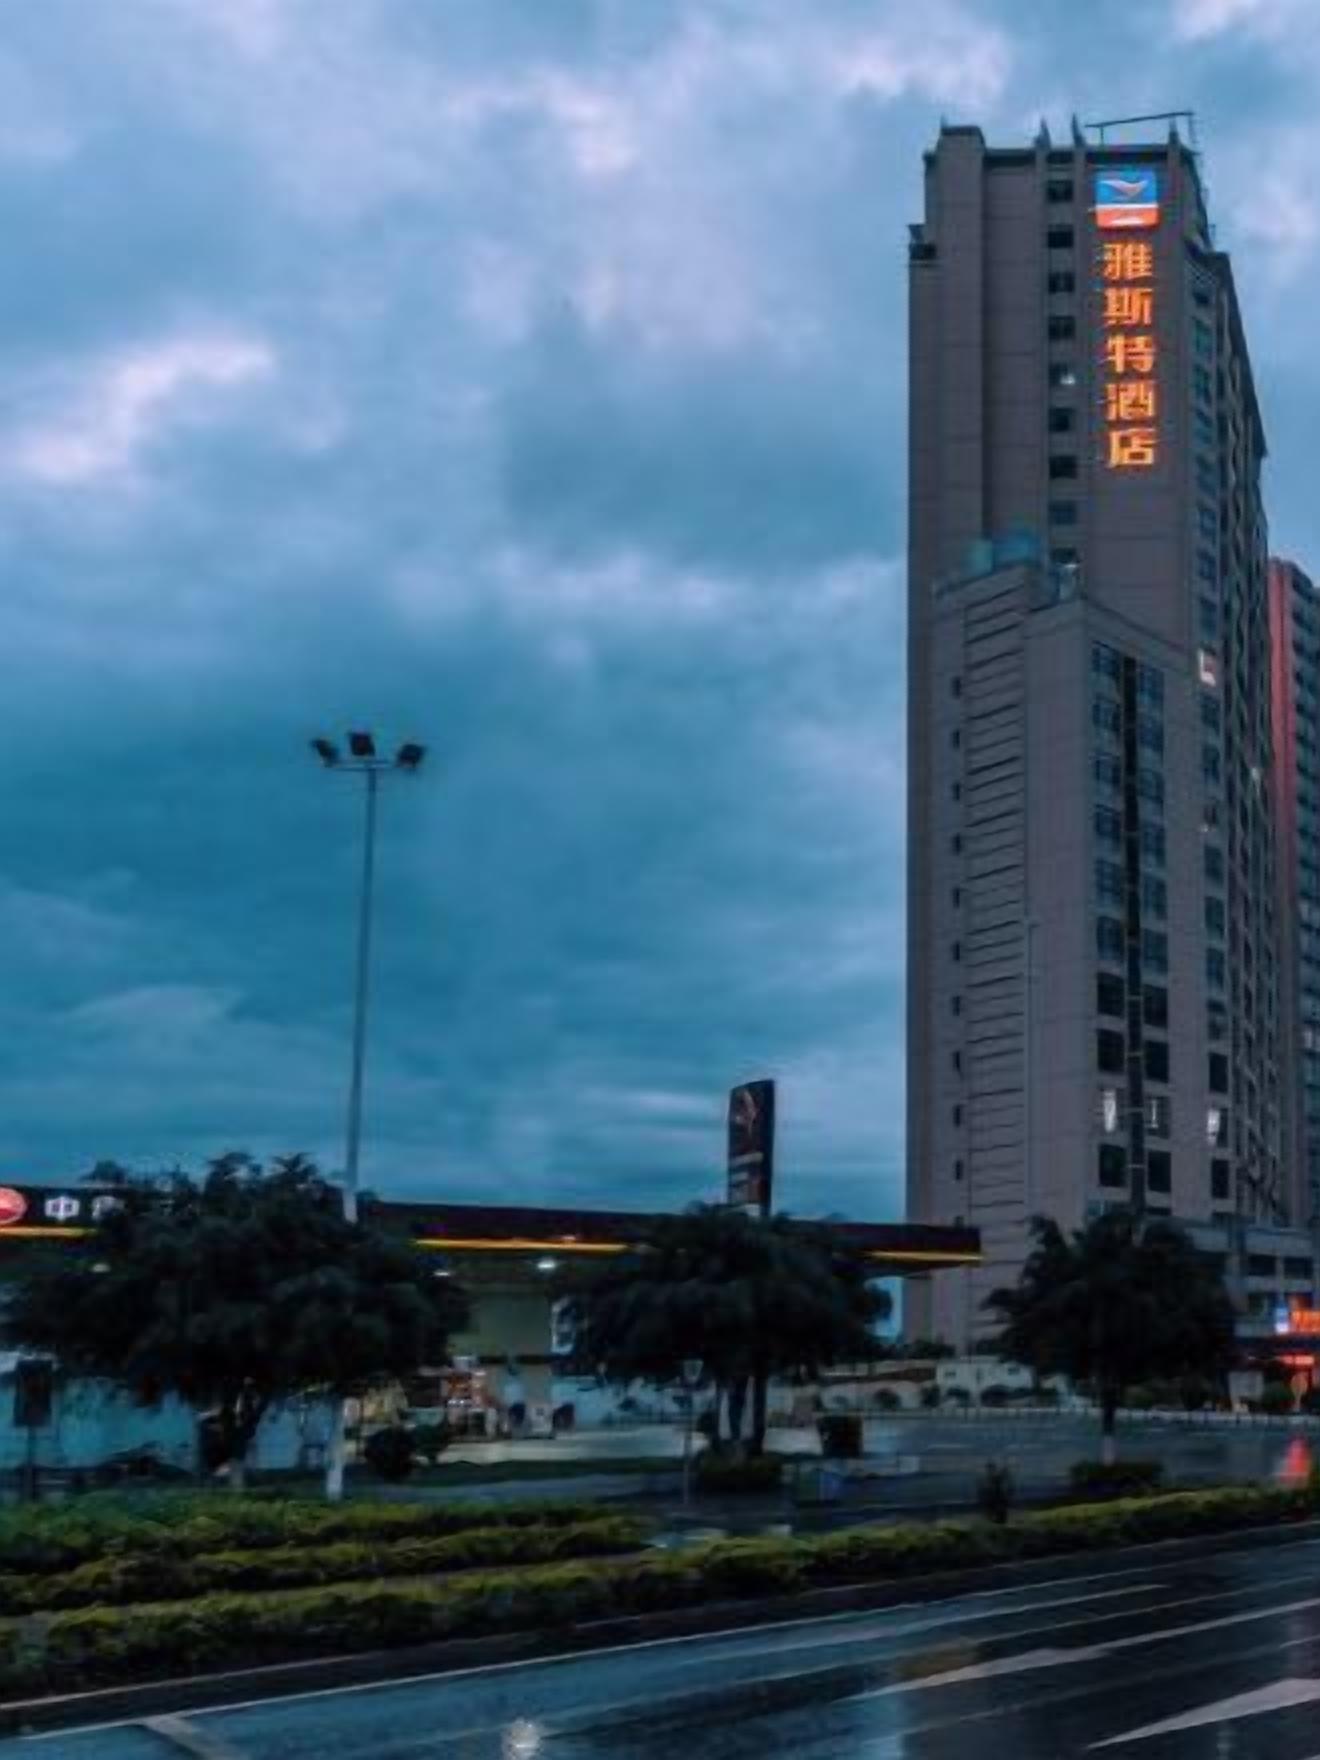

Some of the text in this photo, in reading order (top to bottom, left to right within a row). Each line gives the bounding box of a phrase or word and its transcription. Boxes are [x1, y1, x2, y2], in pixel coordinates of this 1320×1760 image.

[1102, 242, 1155, 467] 雅斯特酒店
